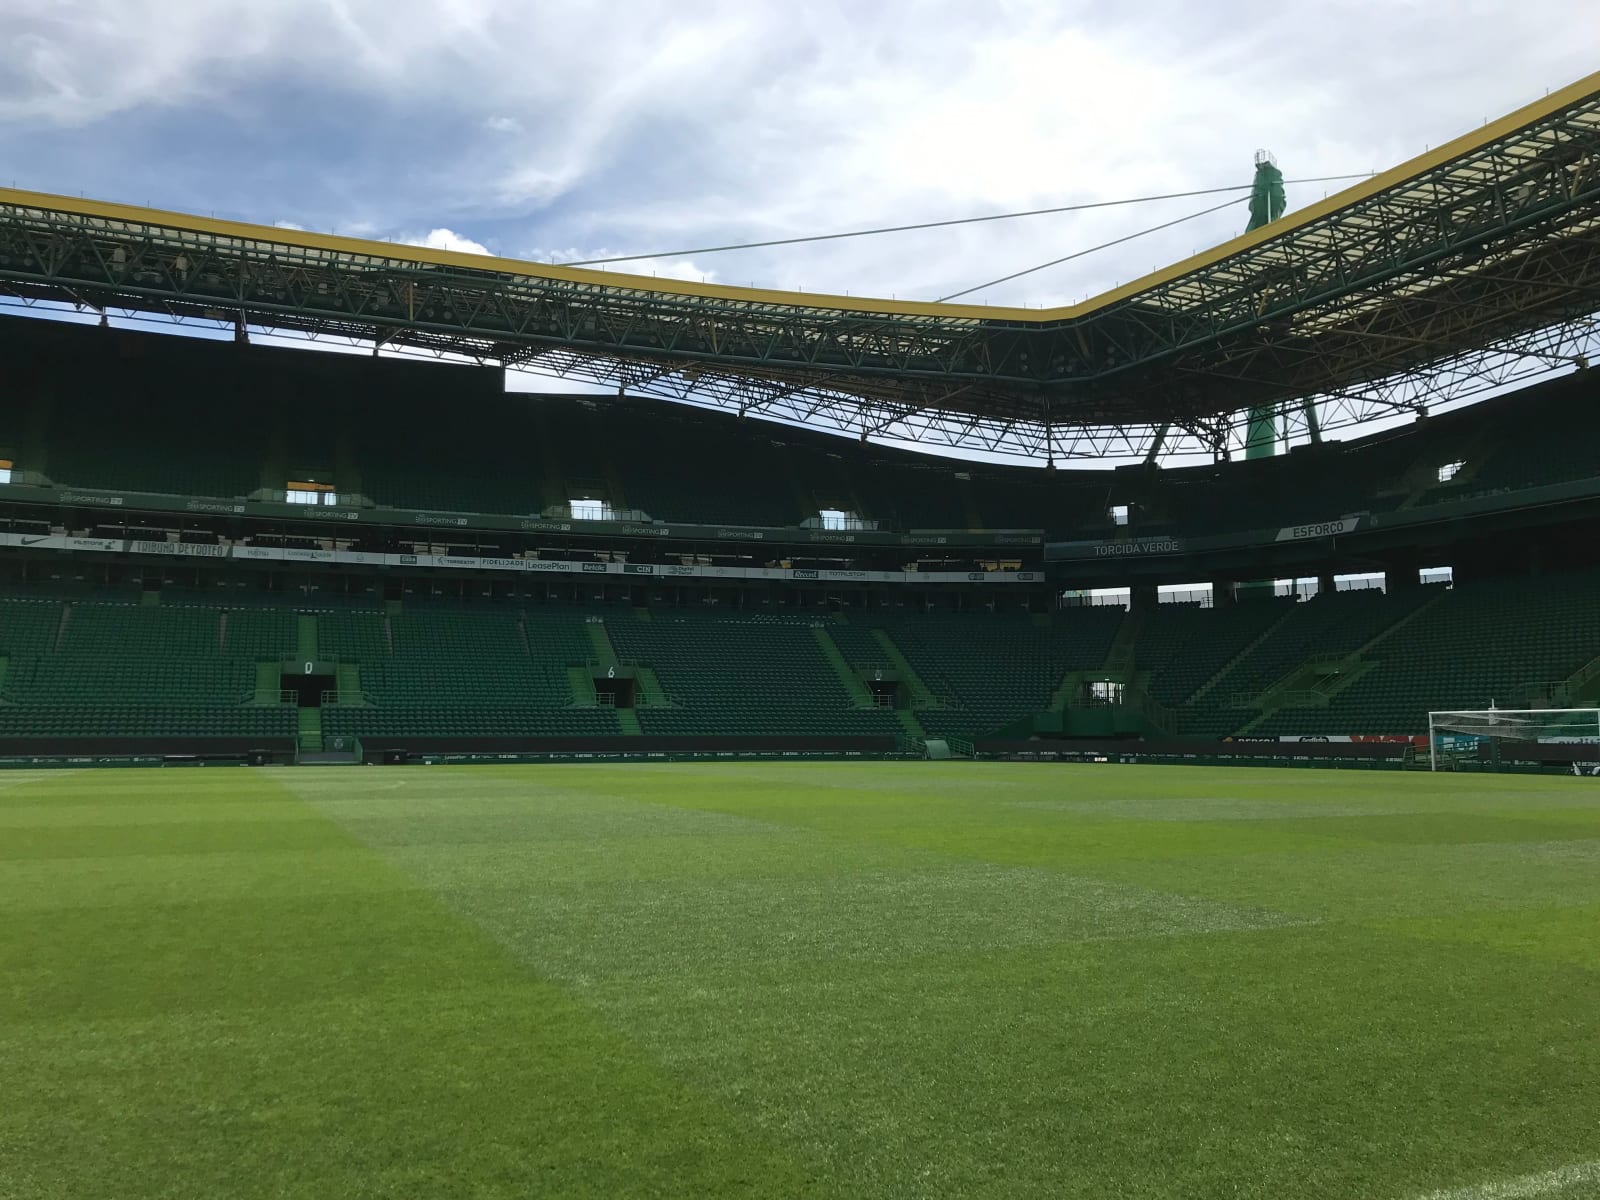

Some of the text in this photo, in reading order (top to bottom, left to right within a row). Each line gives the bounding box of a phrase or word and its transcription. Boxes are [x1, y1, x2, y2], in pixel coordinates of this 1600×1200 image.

[72, 495, 109, 504] SPORTING
[199, 504, 233, 512] SPORTING
[315, 510, 347, 519] SPORTING
[137, 541, 223, 556] TRIBUNA PEYROTEO
[1094, 541, 1179, 556] TORCIDA VERDE
[527, 562, 570, 571] LeasePlan
[608, 666, 615, 678] 6
